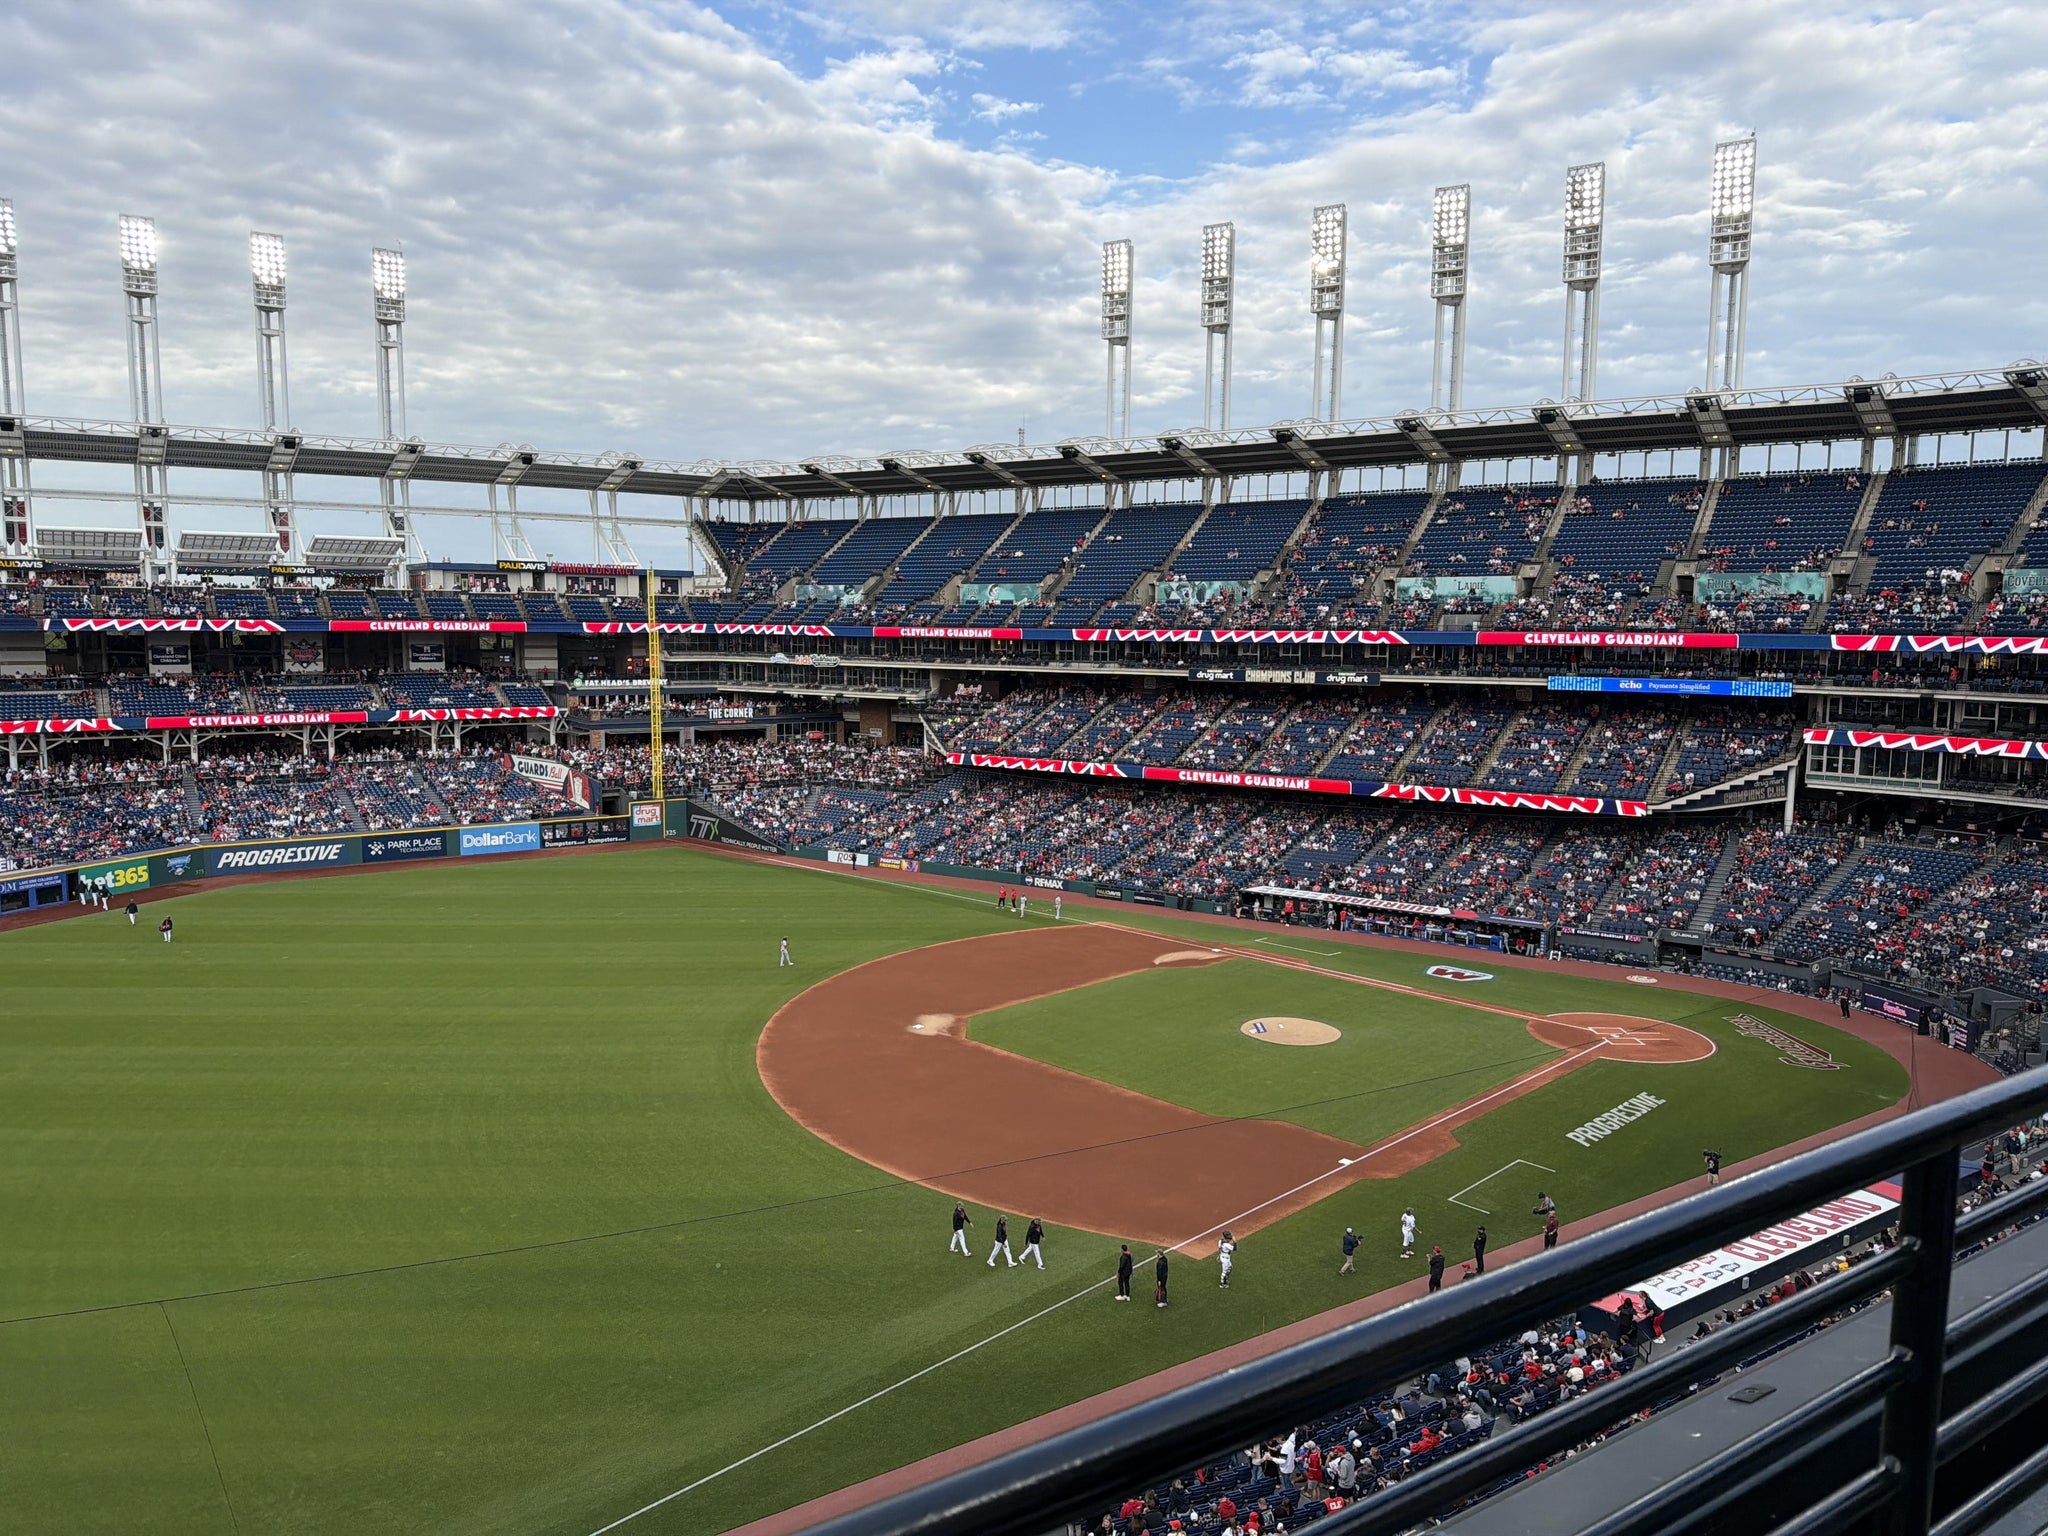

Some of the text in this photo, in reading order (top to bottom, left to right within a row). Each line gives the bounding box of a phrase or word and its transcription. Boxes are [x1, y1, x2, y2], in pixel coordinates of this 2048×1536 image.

[596, 565, 637, 575] DISTRICT
[370, 621, 490, 630] CLEVELAND GUARDIANS
[900, 628, 992, 638] CLEVELAND GUARDIANS
[1524, 633, 1684, 645] CLEVELAND GUARDIANS
[1197, 671, 1214, 680] drug
[1215, 671, 1234, 679] mart
[1246, 670, 1316, 683] CHAMPIONS CLUB
[1326, 674, 1345, 684] drug
[1347, 674, 1368, 683] mart
[633, 679, 668, 687] BREWRY
[1620, 681, 1642, 689] echo
[1649, 682, 1710, 692] Payments Simplified
[709, 707, 753, 719] THE CORNER
[189, 713, 330, 726] CLEVELAND GUARDIANS
[518, 761, 549, 776] GUARDS
[1179, 771, 1310, 789] CLEVELAND GUARDIANS
[1723, 785, 1786, 804] CHAMPIONS CLUB
[635, 805, 657, 816] drug
[637, 814, 661, 823] mart
[388, 837, 442, 849] PARK PLACE
[400, 845, 442, 854] TECHNOLOGIES
[217, 844, 343, 868] PROGRESSIVE
[80, 866, 149, 891] bet365
[1565, 1091, 1666, 1147] PROGRESSIVE
[1722, 1197, 1882, 1262] CLEVELAND
